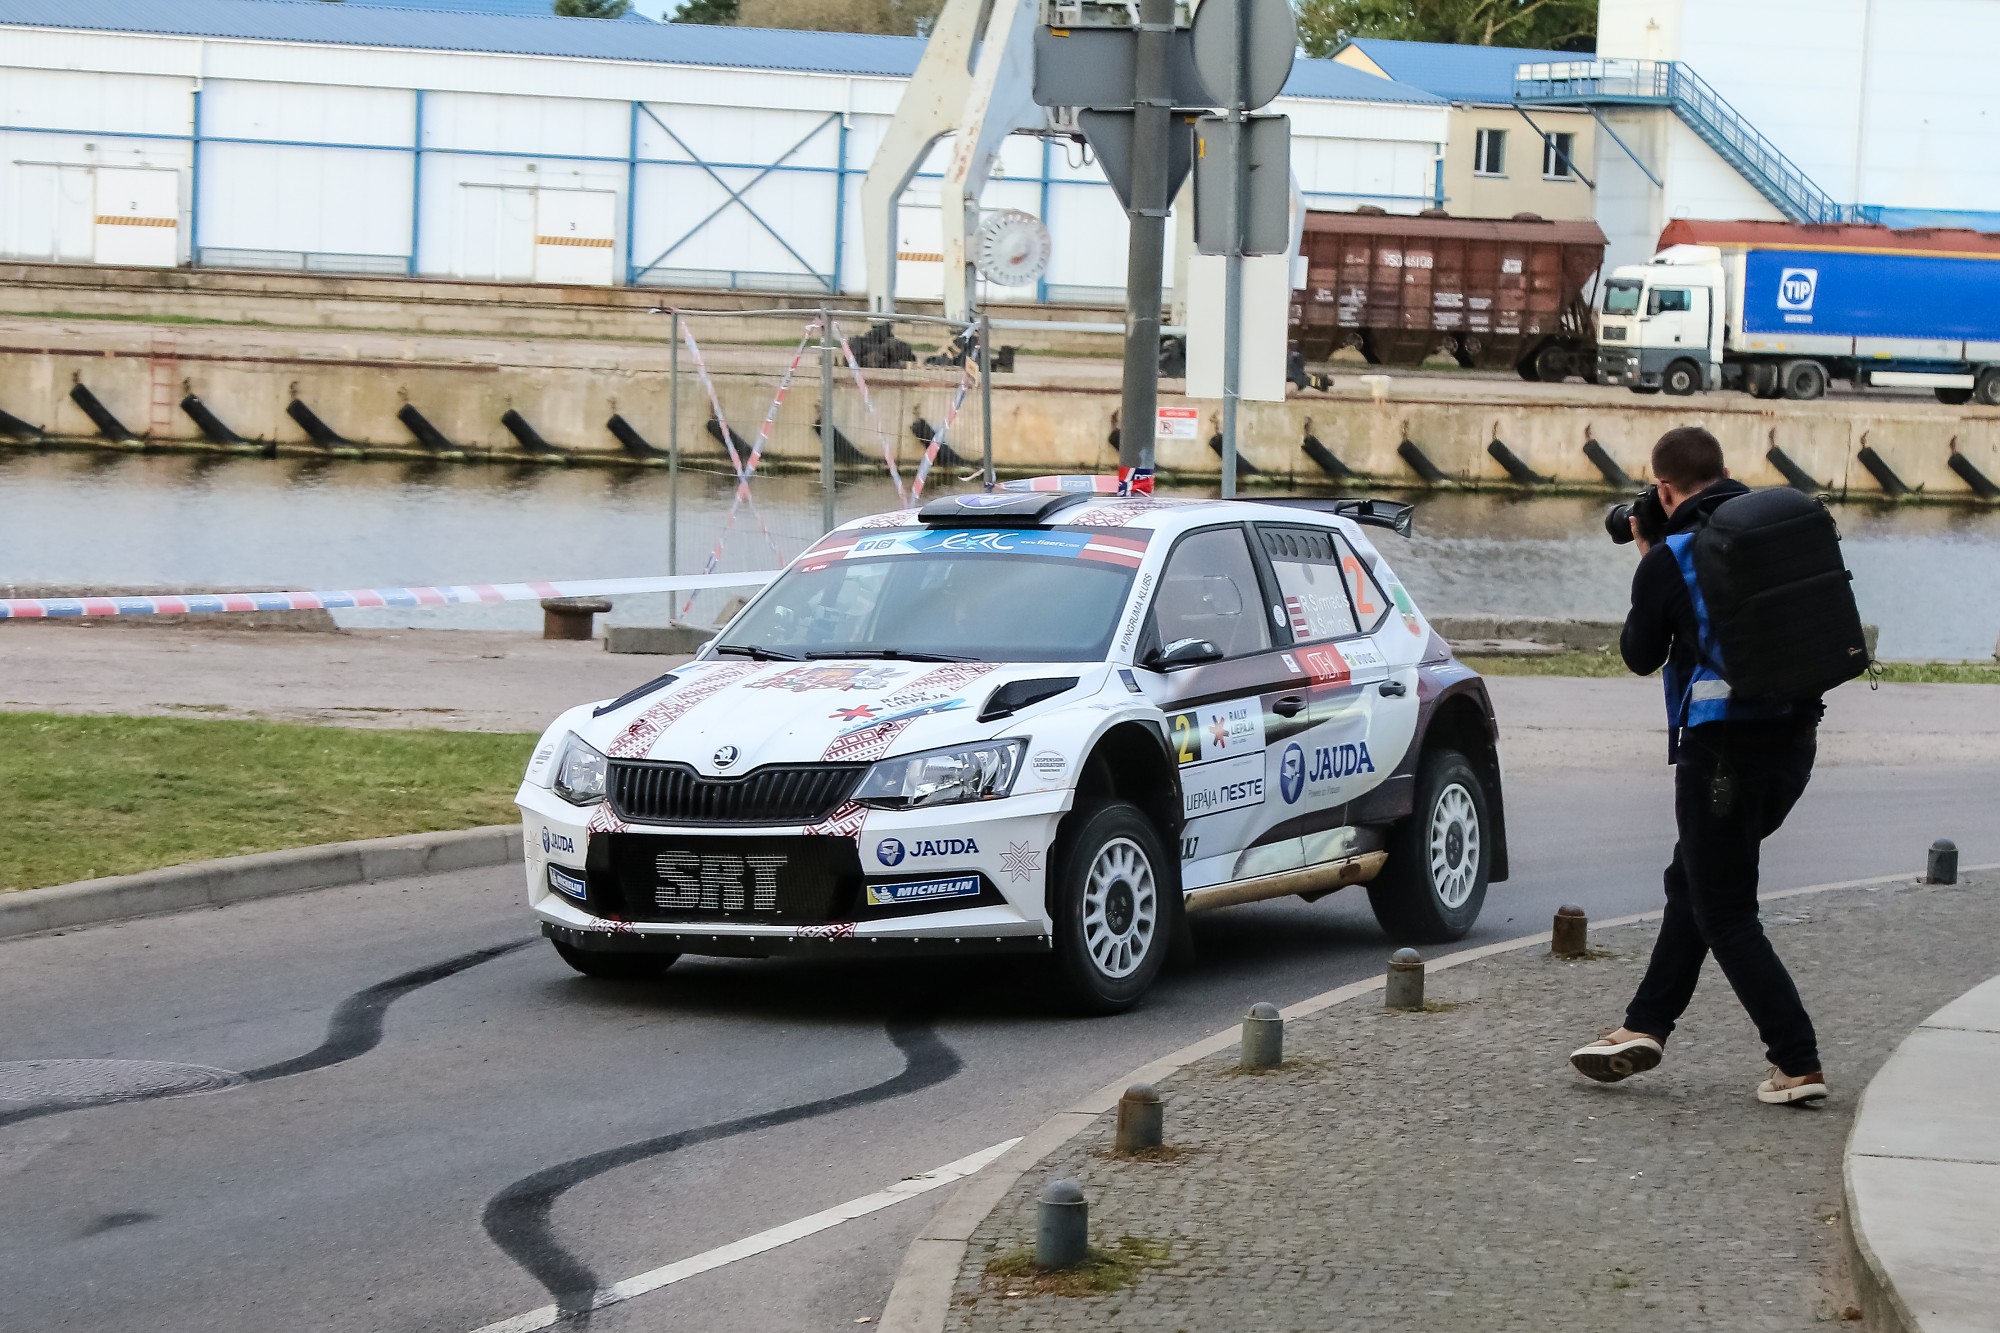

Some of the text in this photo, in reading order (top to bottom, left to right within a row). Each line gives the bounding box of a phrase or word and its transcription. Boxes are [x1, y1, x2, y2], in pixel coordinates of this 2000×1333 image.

[1785, 280, 1811, 301] TIP
[1137, 572, 1153, 602] KLUBS
[1343, 555, 1375, 614] 2
[880, 692, 927, 704] RALLY
[923, 707, 937, 715] 2
[1228, 708, 1248, 720] RALLY
[1175, 714, 1194, 764] 2
[1309, 741, 1375, 783] JAUDA
[1220, 778, 1263, 803] NESTE
[551, 833, 575, 853] JAUDA
[909, 838, 980, 858] JAUDA
[655, 850, 788, 910] SRT
[896, 879, 974, 898] MICHELIN
